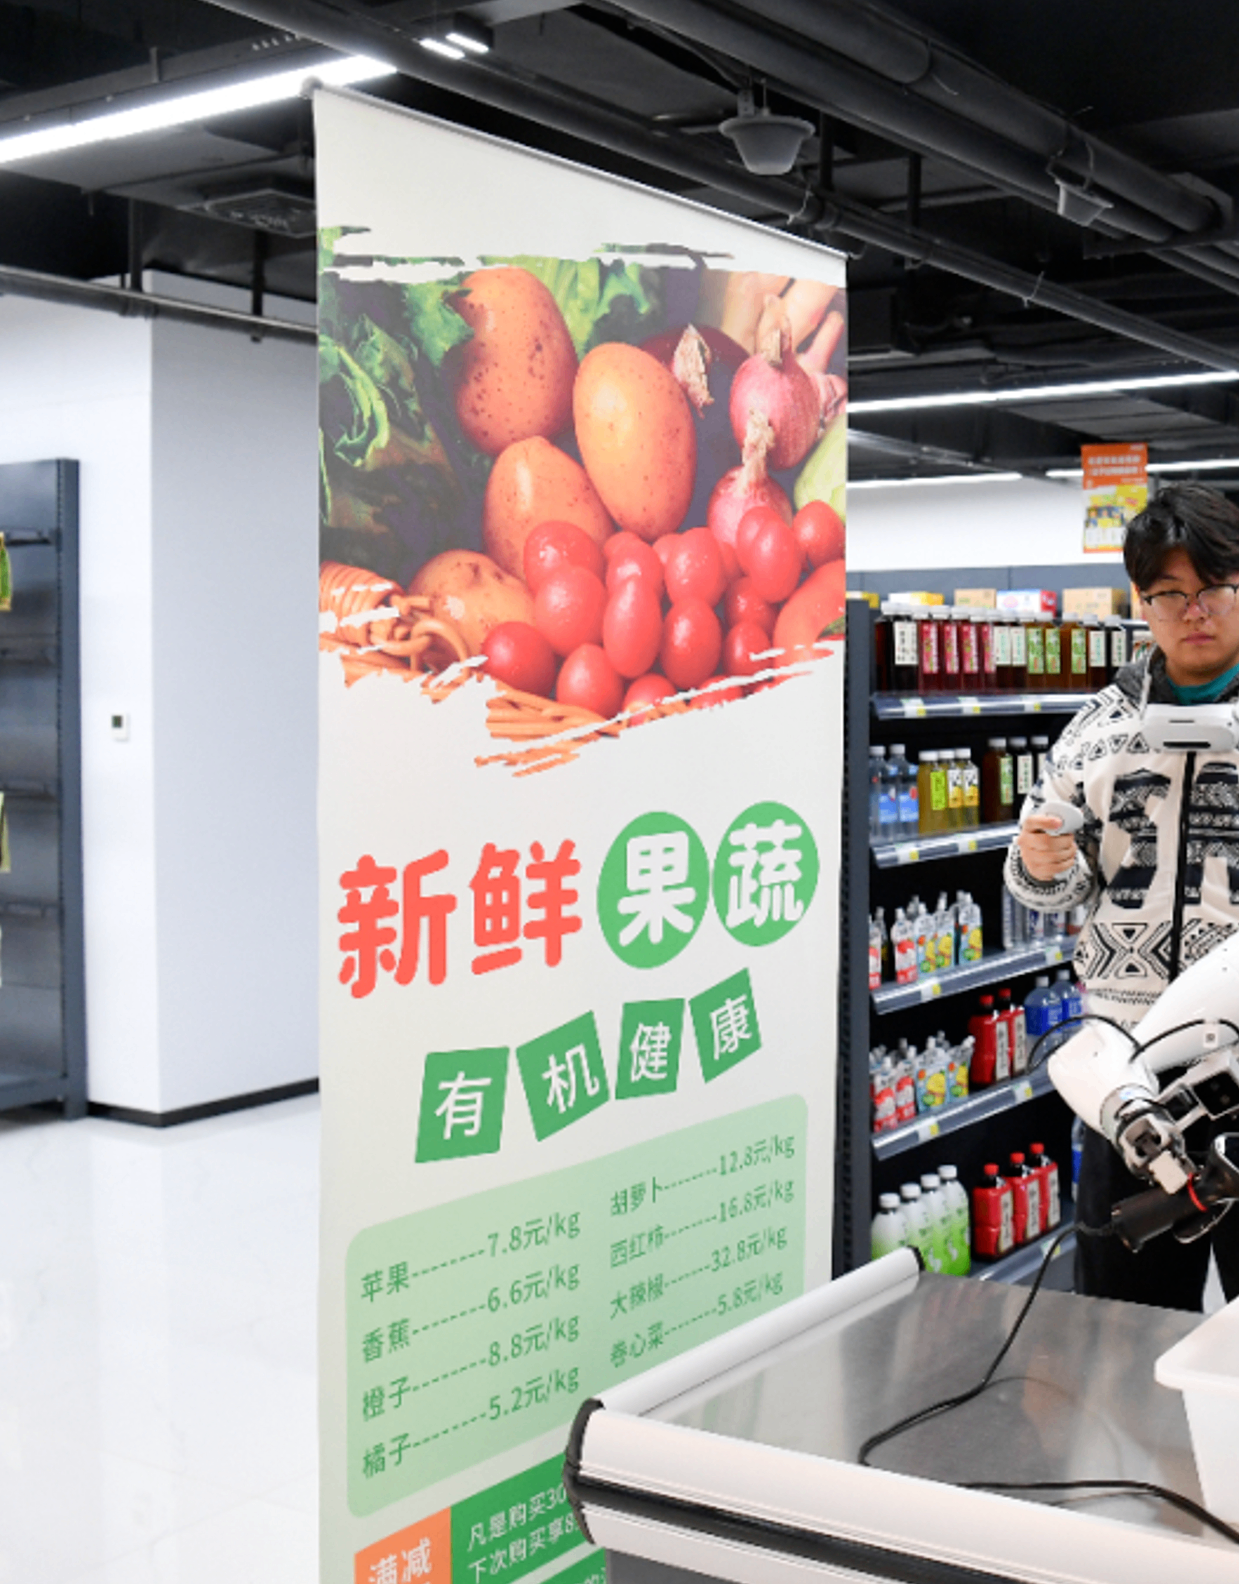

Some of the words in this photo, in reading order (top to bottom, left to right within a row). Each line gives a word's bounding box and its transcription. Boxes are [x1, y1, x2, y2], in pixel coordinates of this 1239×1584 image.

[337, 818, 804, 999] 新鲜果蔬
[434, 992, 753, 1140] 有机健康
[609, 1176, 663, 1217] 胡萝卜
[360, 1261, 410, 1303] 苹果
[487, 1211, 581, 1258] 7.8元/kg
[609, 1223, 664, 1269] 西红柿
[717, 1271, 784, 1316] 5.8元/kg
[361, 1318, 411, 1363] 香蕉
[487, 1263, 581, 1312] 6.6元/kg
[609, 1272, 664, 1321] 大辣椒
[361, 1375, 410, 1422] 橙子
[487, 1315, 580, 1367] 8.8元/kg
[361, 1432, 411, 1479] 橘子
[488, 1366, 580, 1421] 5.2元/kg
